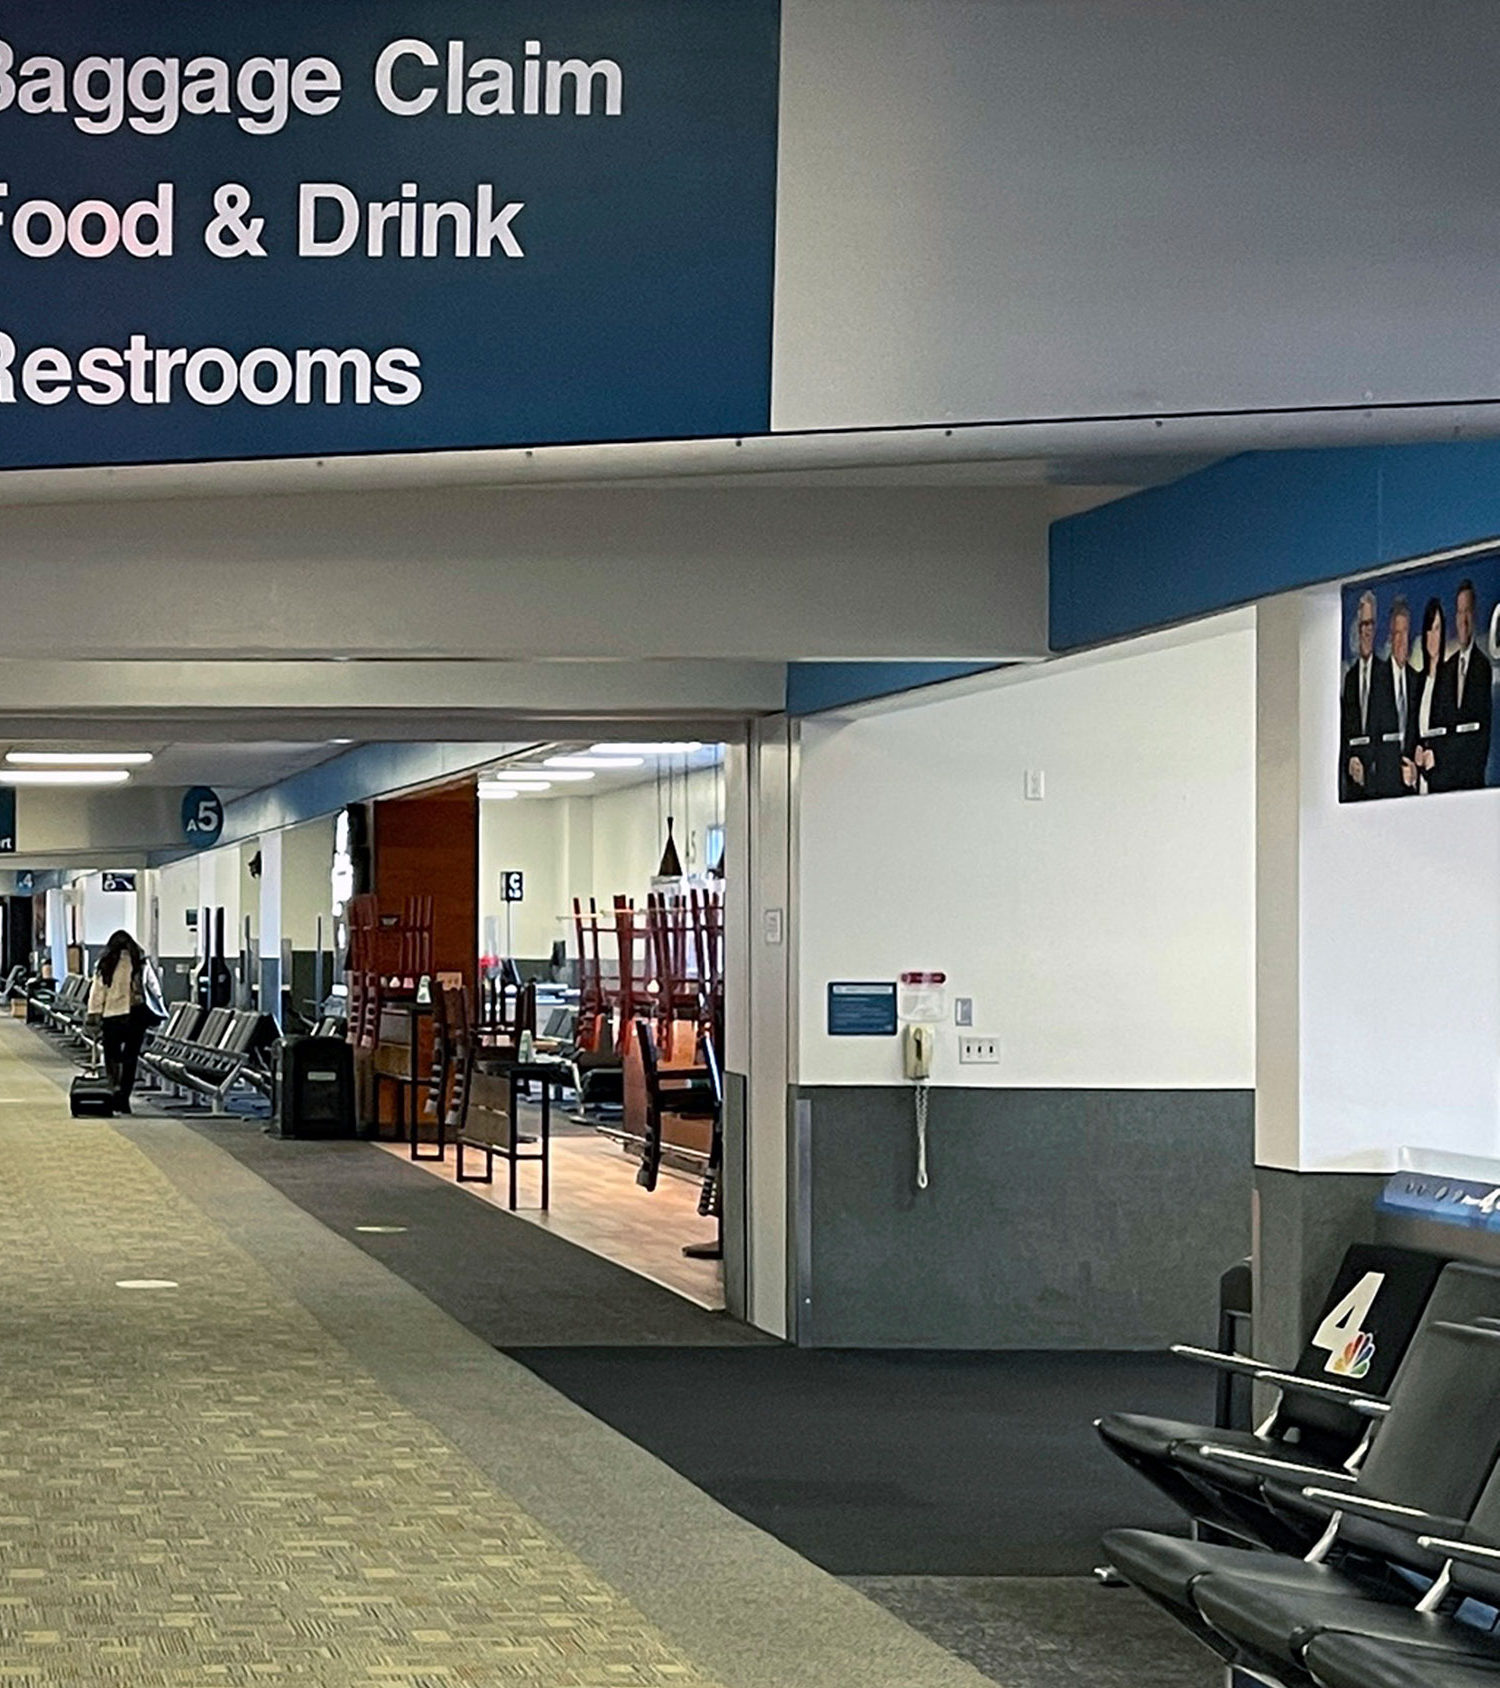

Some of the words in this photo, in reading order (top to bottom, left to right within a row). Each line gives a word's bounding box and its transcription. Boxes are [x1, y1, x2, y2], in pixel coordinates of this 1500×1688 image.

[375, 38, 622, 118] Claim
[204, 183, 268, 259] &
[298, 182, 525, 259] Drink
[1311, 1271, 1386, 1379] 4
